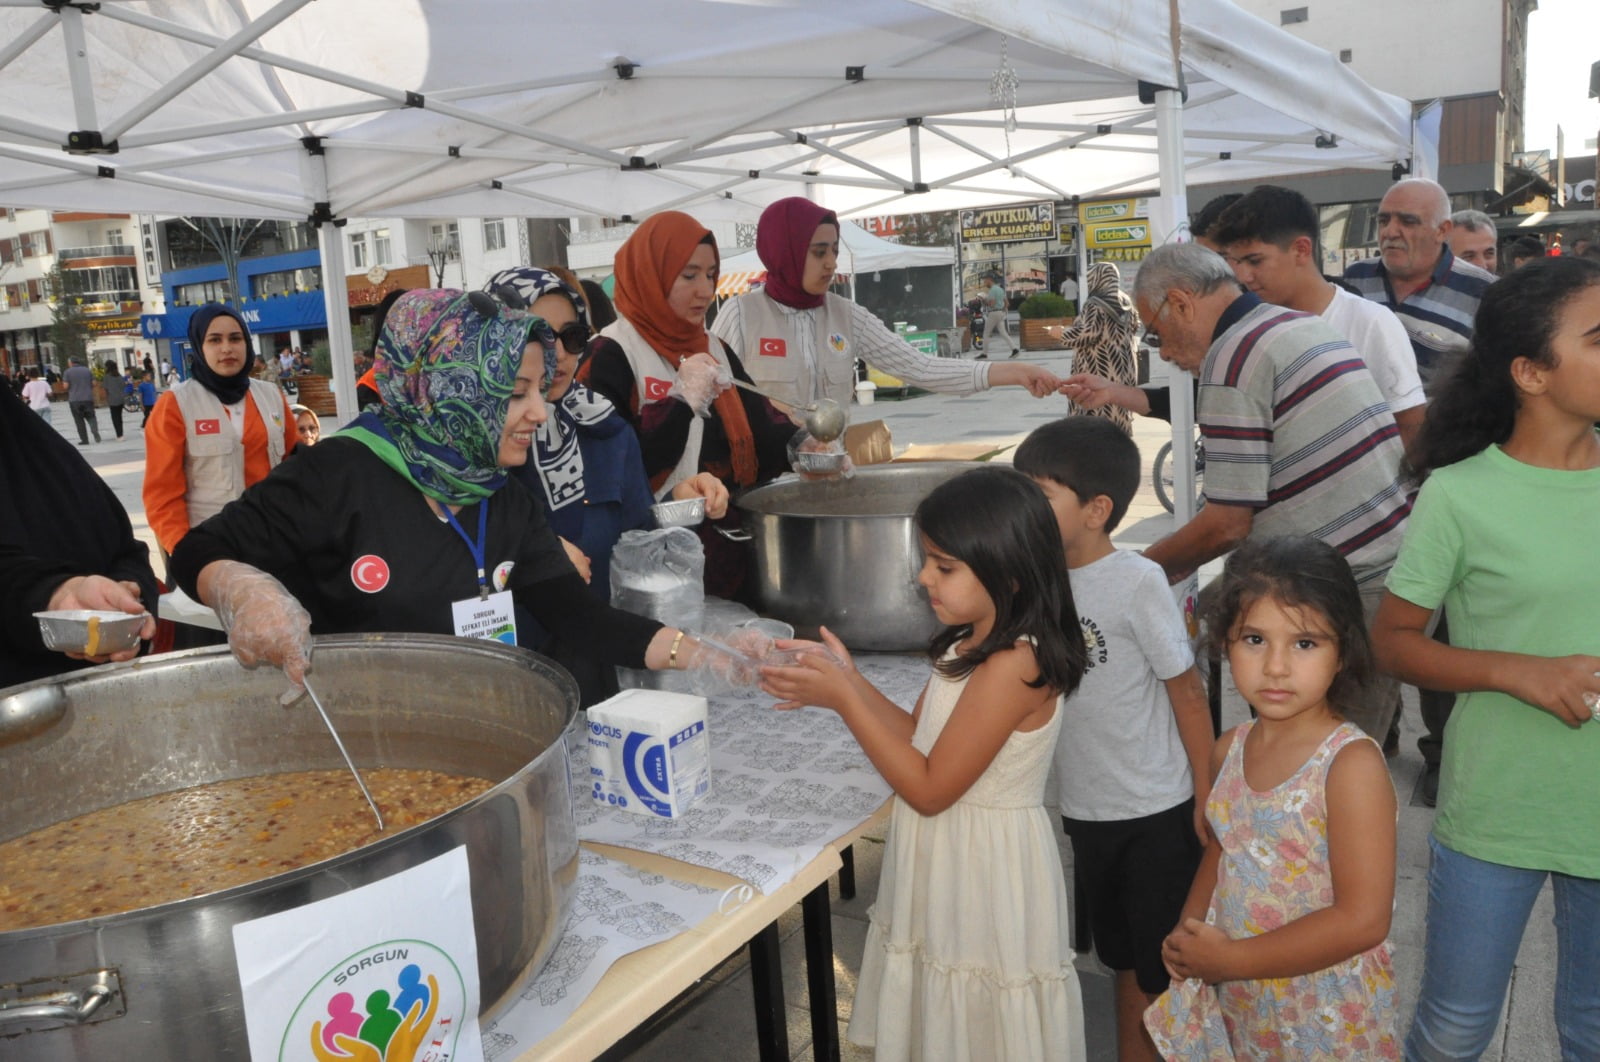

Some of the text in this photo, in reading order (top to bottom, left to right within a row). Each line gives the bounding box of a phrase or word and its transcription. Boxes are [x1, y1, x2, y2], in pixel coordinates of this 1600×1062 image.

[986, 207, 1037, 224] TUTKUM
[963, 226, 998, 238] ERKEK
[1001, 221, 1051, 235] KUAFÖRÜ
[1097, 230, 1130, 241] iddaa
[1080, 616, 1105, 647] AFRAID
[1099, 649, 1107, 663] TO
[587, 720, 622, 739] FOCUS
[655, 757, 663, 781] EXTRA
[333, 949, 409, 986] SORGUN
